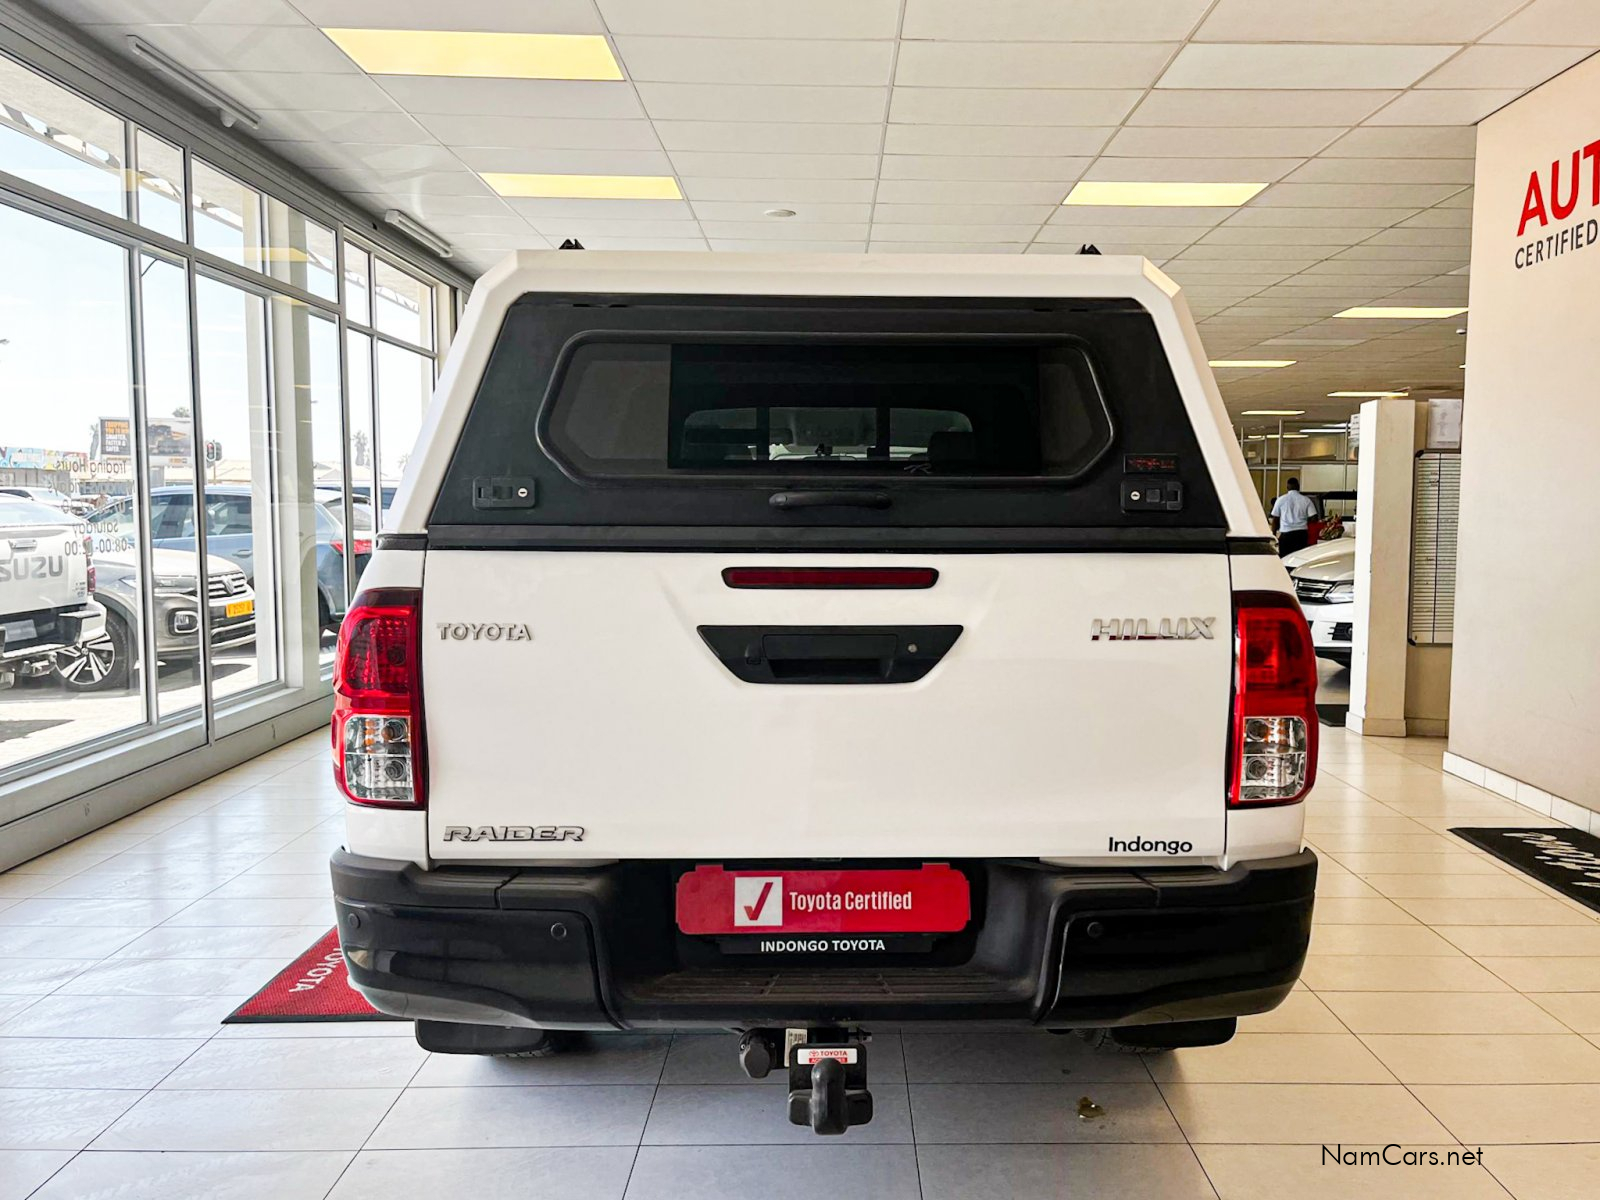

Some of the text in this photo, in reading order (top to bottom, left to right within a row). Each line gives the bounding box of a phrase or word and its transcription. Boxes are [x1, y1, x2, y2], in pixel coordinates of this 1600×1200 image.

[1515, 218, 1598, 270] CERTIFIED
[436, 623, 533, 641] TOYOTA
[1091, 617, 1217, 641] HILUX
[443, 826, 585, 842] RAIDER
[1108, 836, 1193, 855] Indongo
[790, 891, 912, 912] Toyota Certified
[760, 939, 886, 953] INDONGO TOYOTA
[288, 948, 345, 993] OYOTA
